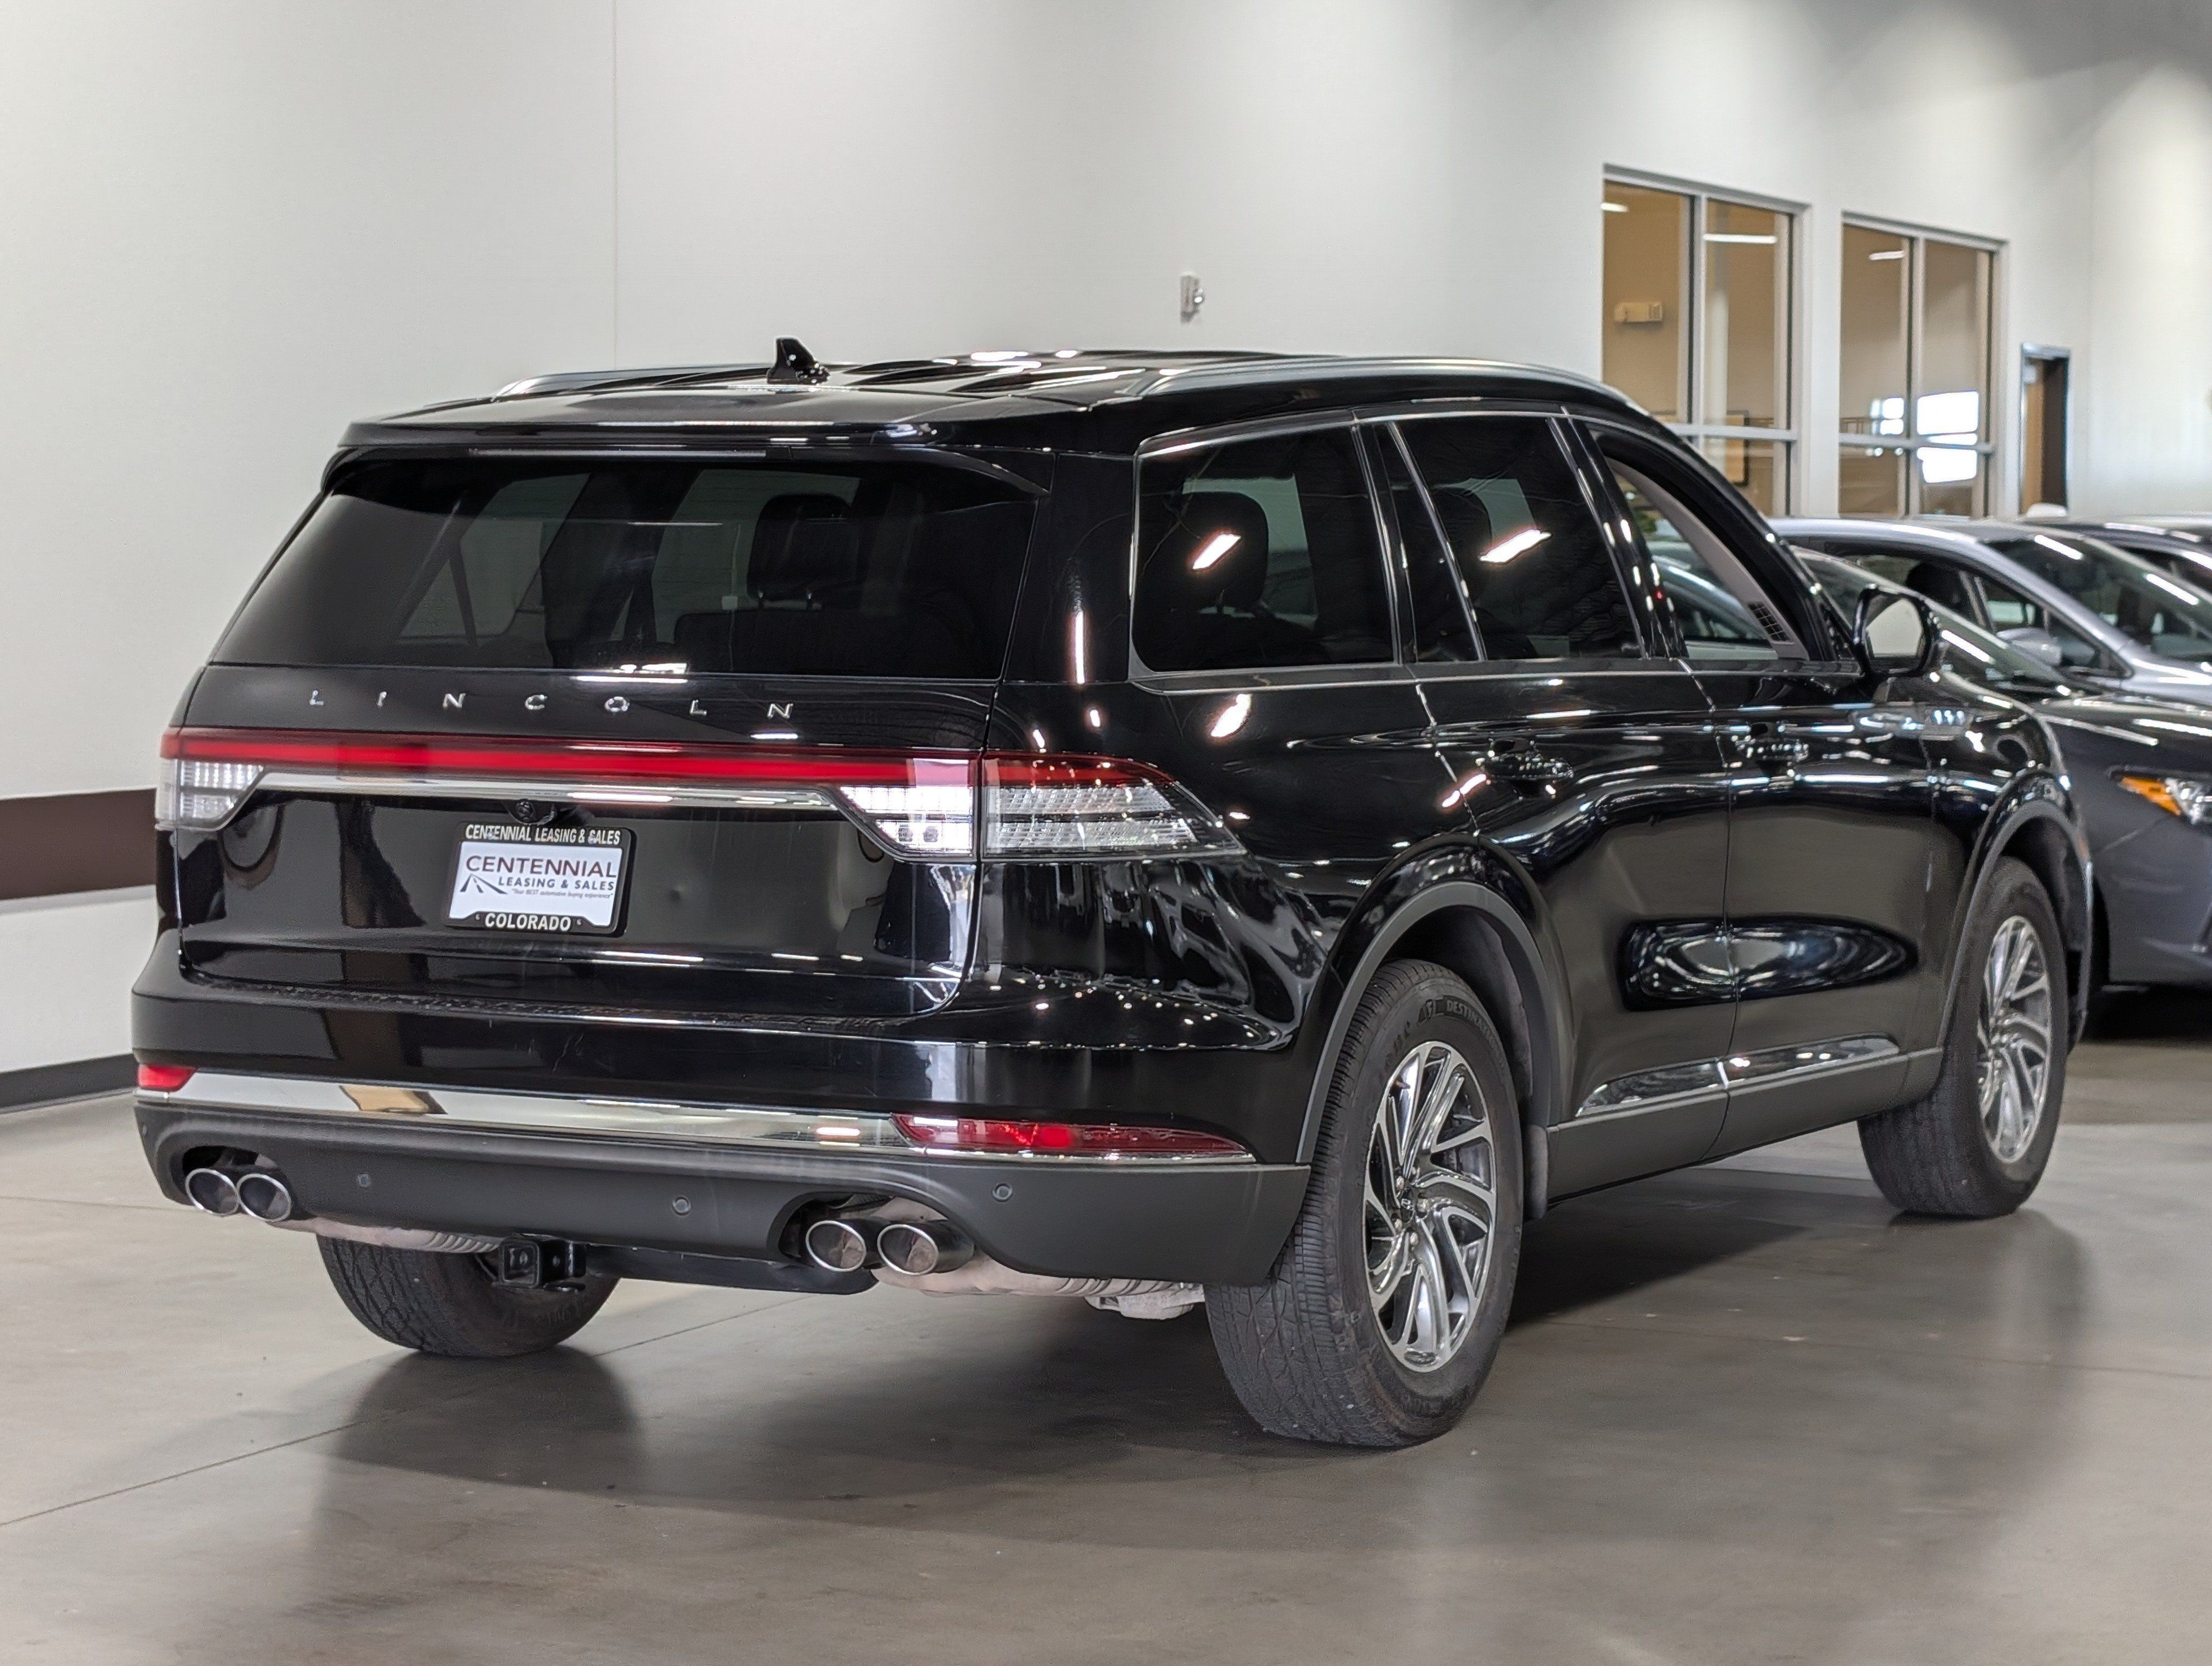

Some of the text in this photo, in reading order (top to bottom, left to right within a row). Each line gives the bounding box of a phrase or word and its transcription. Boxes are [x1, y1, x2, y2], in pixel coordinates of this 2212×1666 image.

[310, 690, 794, 720] LINCOLN
[465, 824, 621, 845] CENTENNIAL LEASING & SALES
[466, 855, 617, 878] CENTENNIAL
[498, 876, 614, 890] LEASING & SALES
[485, 913, 571, 932] COLORADO
